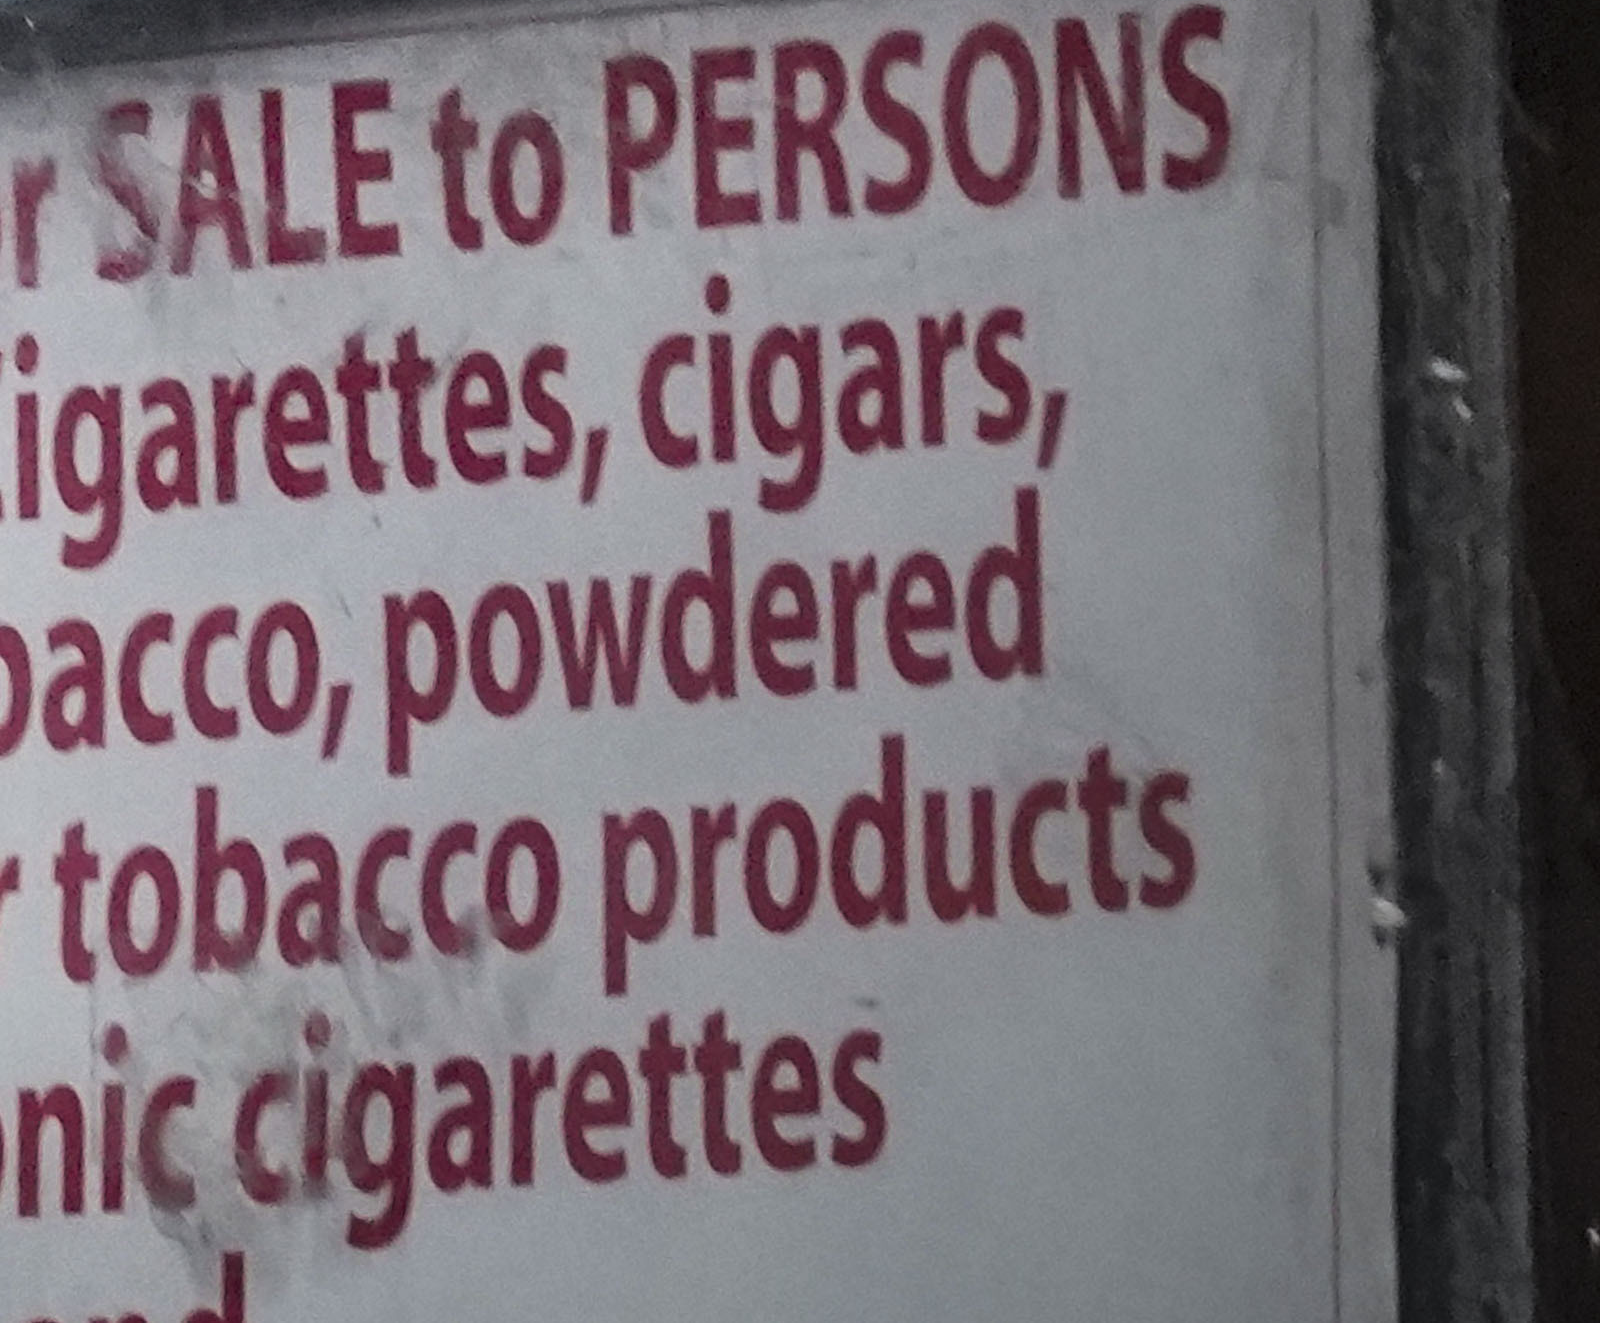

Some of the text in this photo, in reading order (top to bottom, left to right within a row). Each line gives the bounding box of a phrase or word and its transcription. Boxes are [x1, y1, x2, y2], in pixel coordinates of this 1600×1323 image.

[97, 78, 402, 285] SALE
[429, 86, 565, 253] to
[605, 3, 1233, 237] PERSONS
[637, 274, 1070, 513] cigars,
[384, 485, 1046, 778] powdered
[52, 786, 563, 986] tobacco
[602, 733, 1199, 998] products
[234, 1007, 889, 1251] cigarettes
